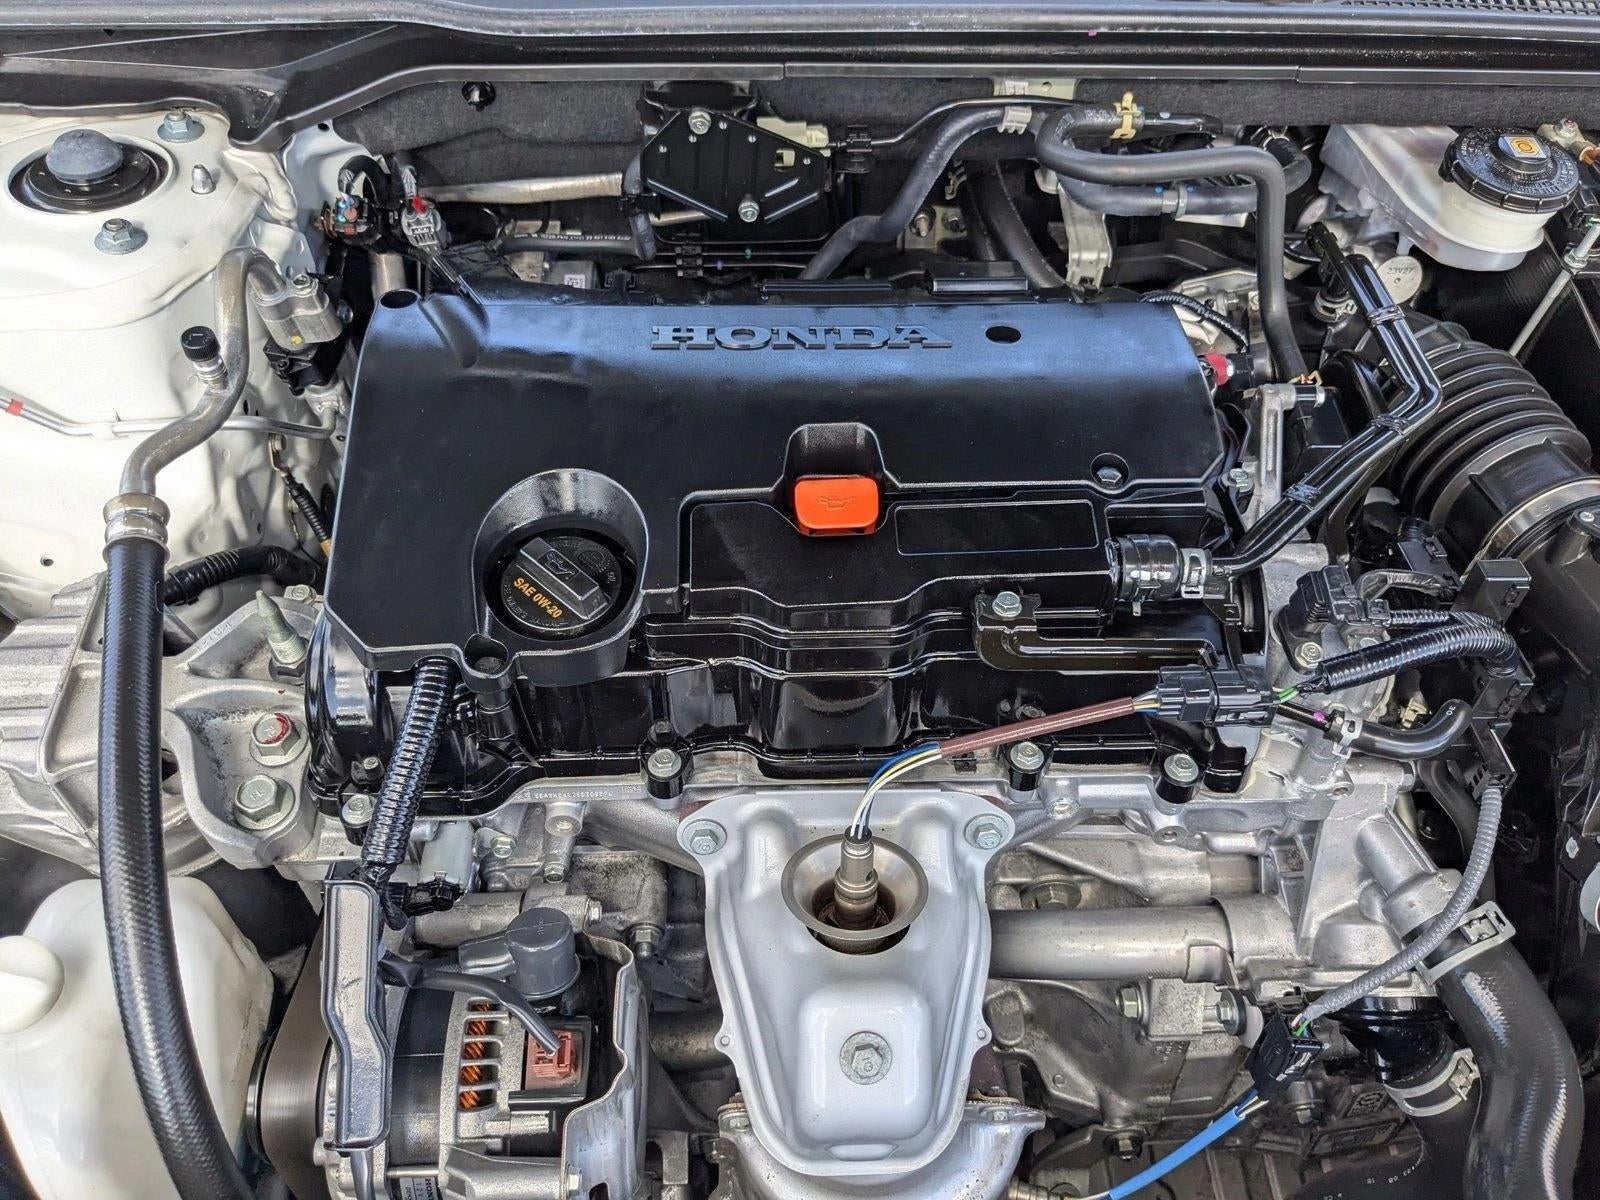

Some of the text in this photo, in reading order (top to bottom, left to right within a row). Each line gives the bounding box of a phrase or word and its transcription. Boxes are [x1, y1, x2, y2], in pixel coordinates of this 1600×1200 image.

[651, 325, 953, 350] HONDA
[513, 577, 535, 597] SAE
[533, 593, 563, 619] 0W-20
